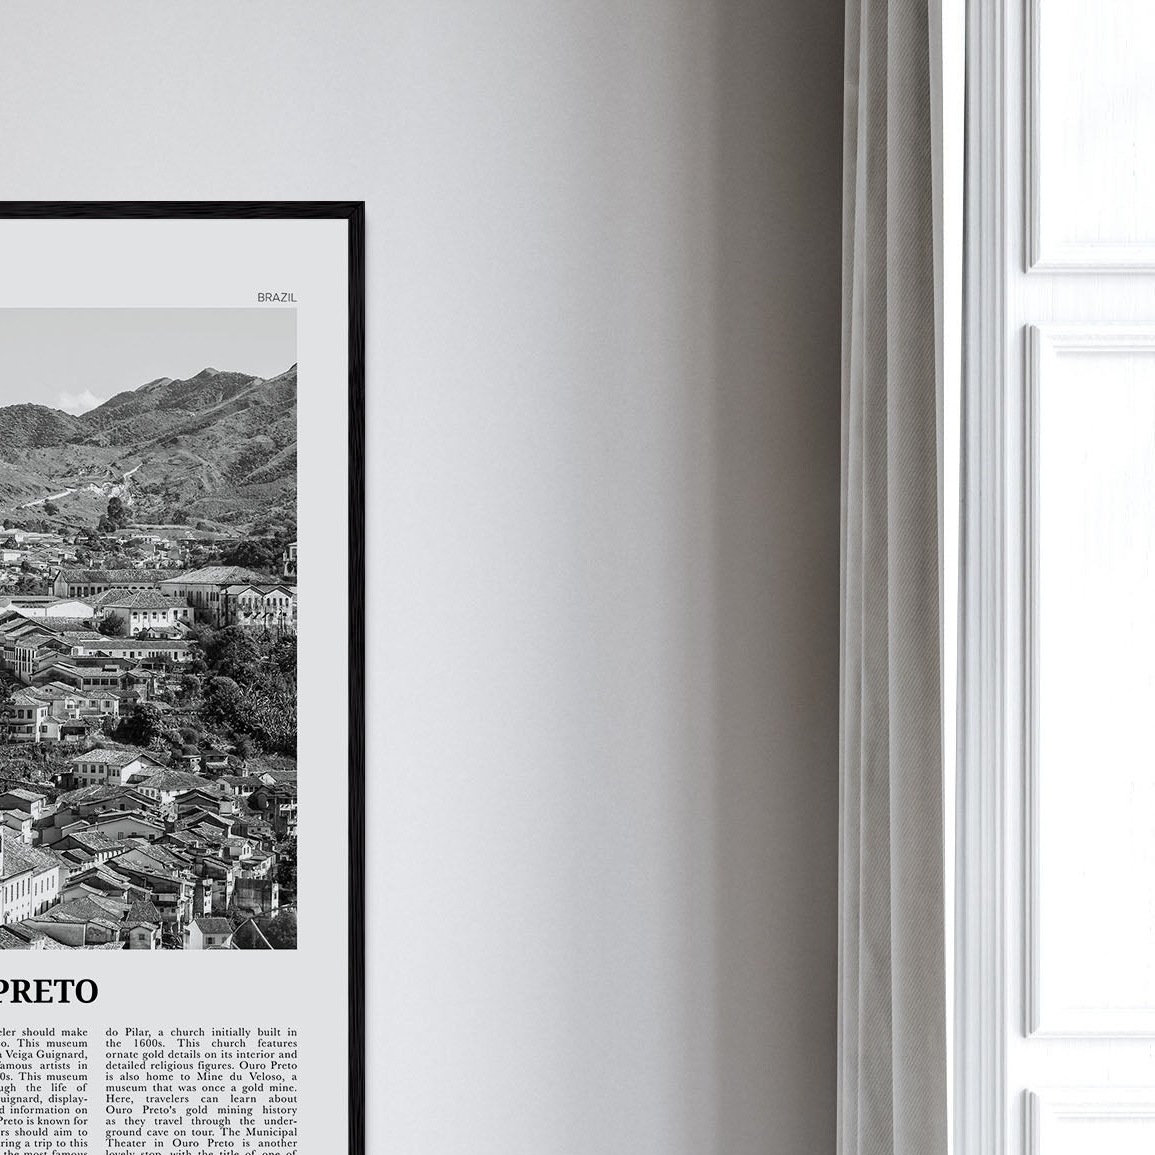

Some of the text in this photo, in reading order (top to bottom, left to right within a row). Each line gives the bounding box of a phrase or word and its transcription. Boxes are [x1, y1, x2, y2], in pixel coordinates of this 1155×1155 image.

[257, 292, 297, 303] BRAZIL
[22, 1028, 55, 1036] should
[61, 1028, 88, 1036] make
[17, 1039, 40, 1047] This
[106, 1039, 298, 1047] the 1600s. This church features
[5, 1050, 33, 1061] Veiga
[36, 1050, 88, 1061] Guignard,
[105, 1051, 139, 1059] ornate
[142, 1050, 164, 1061] gold
[167, 1050, 201, 1059] details
[221, 1050, 233, 1059] its
[236, 1050, 276, 1059] interior
[278, 1050, 298, 1059] and
[105, 1061, 298, 1072] detailed religious figures. Ouro Preto
[19, 1072, 42, 1081] This
[26, 1083, 42, 1092] the
[51, 1083, 67, 1092] life
[76, 1083, 87, 1092] of
[48, 1094, 88, 1105] display-
[106, 1094, 134, 1104] Here,
[146, 1094, 190, 1103] travelers
[230, 1094, 257, 1103] learn
[269, 1094, 297, 1103] about
[105, 1105, 298, 1116] Ouro Preto's gold mining history
[124, 1117, 146, 1127] they
[154, 1117, 183, 1125] travel
[191, 1117, 231, 1127] through
[240, 1117, 256, 1125] the
[264, 1117, 297, 1125] under-
[15, 1128, 48, 1136] should
[53, 1128, 73, 1136] aim
[106, 1128, 142, 1138] ground
[220, 1128, 241, 1136] The
[246, 1128, 298, 1138] Municipal
